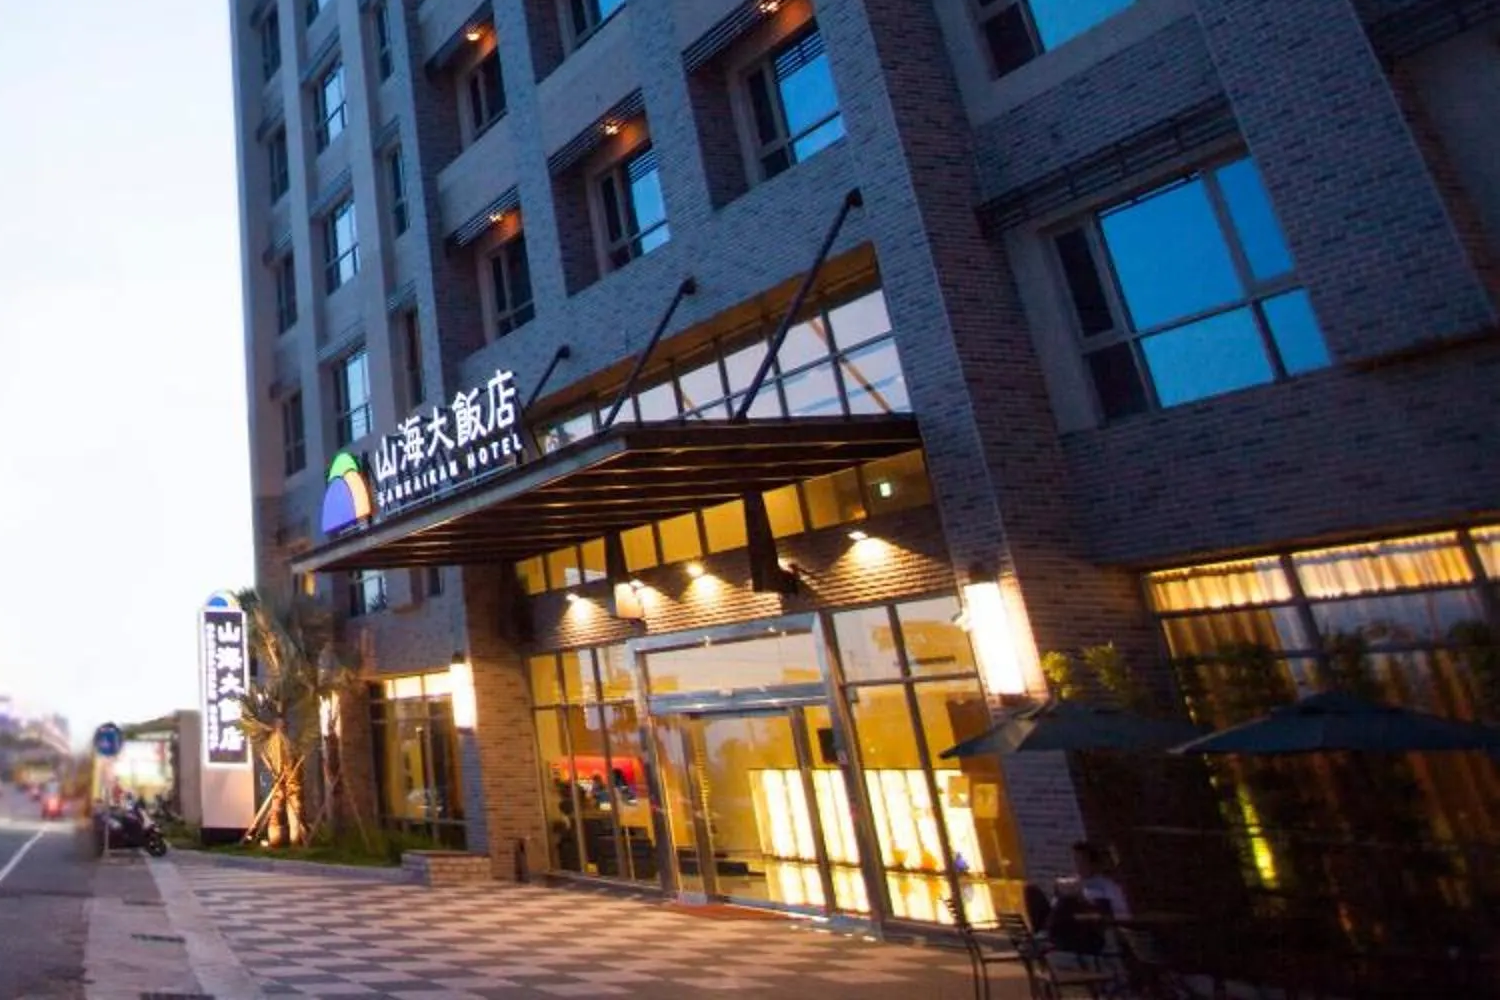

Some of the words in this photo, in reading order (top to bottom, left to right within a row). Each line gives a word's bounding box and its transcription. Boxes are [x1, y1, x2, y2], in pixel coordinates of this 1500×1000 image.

[375, 369, 519, 481] 山海大飯店
[467, 433, 522, 470] HOTEL
